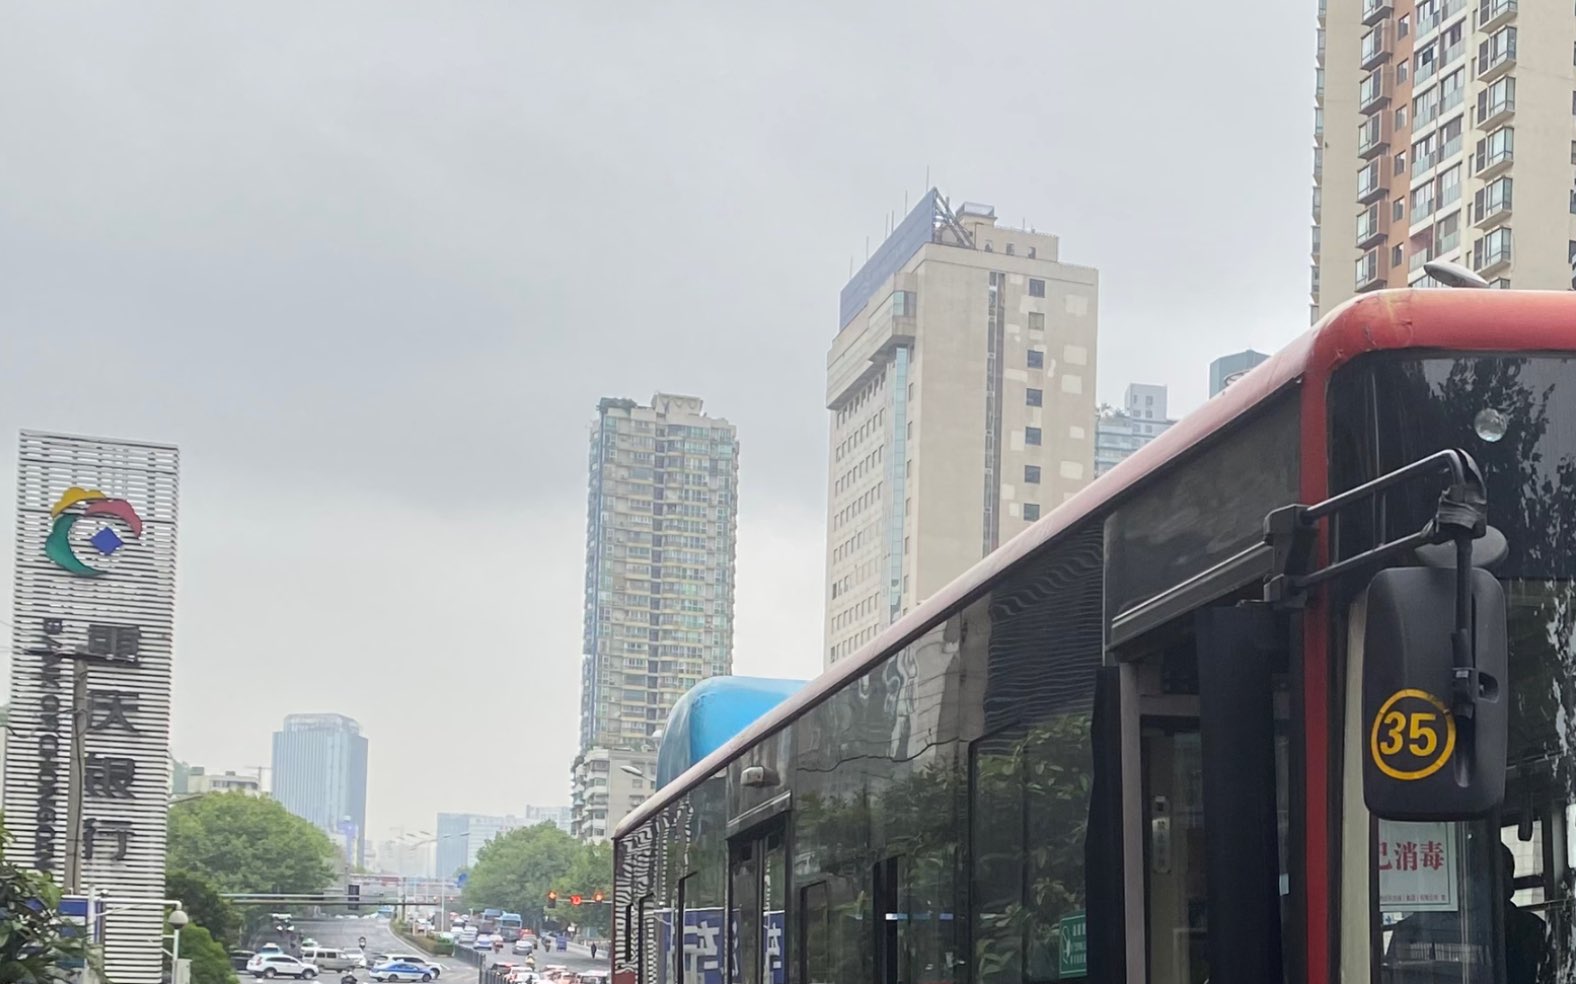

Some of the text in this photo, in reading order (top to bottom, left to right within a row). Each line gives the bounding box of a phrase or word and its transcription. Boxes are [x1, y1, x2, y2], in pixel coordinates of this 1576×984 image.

[82, 622, 142, 862] 重庆银行
[1379, 711, 1438, 757] 35
